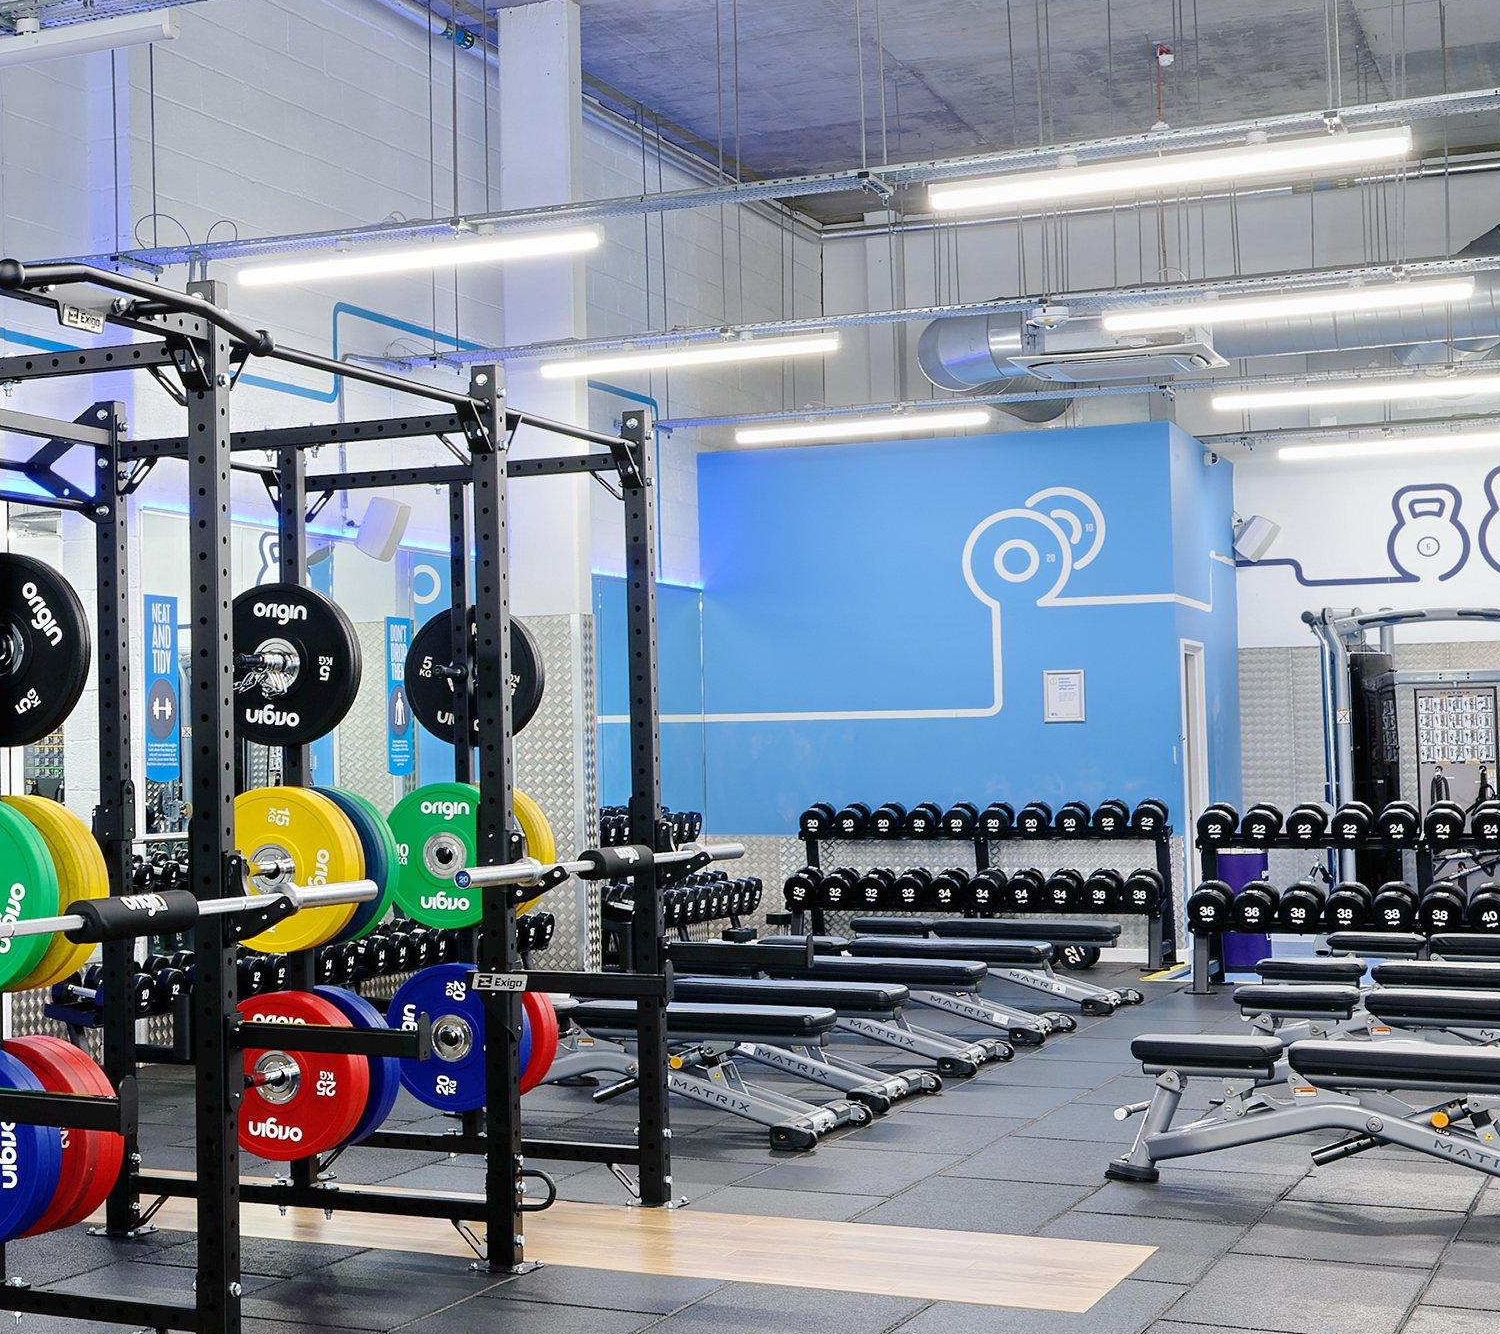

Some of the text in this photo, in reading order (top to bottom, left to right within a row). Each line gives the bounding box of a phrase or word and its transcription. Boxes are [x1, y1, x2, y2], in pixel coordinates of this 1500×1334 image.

[1085, 523, 1094, 531] 10
[1046, 553, 1056, 562] 20
[21, 581, 64, 647] origin
[152, 603, 171, 623] NEAT
[253, 602, 308, 626] origin
[152, 624, 172, 649] AND
[390, 625, 407, 642] DON'T
[152, 649, 172, 674] TIDY
[318, 656, 333, 667] KG
[422, 656, 432, 669] 5
[318, 666, 330, 681] 5
[418, 668, 432, 679] KG
[245, 704, 300, 728] origin
[420, 800, 470, 821] origin
[807, 819, 818, 827] 20
[843, 819, 854, 827] 20
[878, 819, 889, 827] 20
[914, 819, 925, 827] 20
[950, 819, 963, 827] 20
[987, 819, 999, 828] 20
[1025, 819, 1037, 828] 20
[1064, 819, 1076, 827] 20
[1102, 817, 1114, 827] 22
[1141, 817, 1153, 827] 22
[1208, 825, 1221, 833] 22
[1252, 825, 1265, 833] 22
[1298, 825, 1312, 833] 22
[1343, 824, 1357, 833] 22
[1390, 824, 1404, 833] 24
[1436, 824, 1450, 833] 24
[1484, 824, 1498, 833] 24
[458, 875, 468, 885] 20
[794, 887, 805, 896] 32
[829, 888, 841, 896] 32
[865, 889, 877, 897] 32
[902, 889, 915, 897] 32
[939, 889, 951, 897] 34
[976, 890, 989, 898] 34
[1015, 889, 1028, 898] 34
[1054, 890, 1066, 899] 34
[1093, 890, 1106, 899] 36
[1133, 890, 1146, 899] 36
[120, 893, 169, 917] origin
[420, 891, 470, 911] origin
[1200, 907, 1214, 916] 36
[1245, 907, 1260, 917] 36
[1291, 908, 1305, 918] 38
[1338, 909, 1352, 919] 38
[1385, 909, 1400, 919] 38
[1432, 910, 1448, 921] 38
[1482, 911, 1498, 922] 40
[1064, 945, 1081, 964] 22
[494, 979, 522, 989] Exigo
[1010, 971, 1049, 989] MATR
[142, 989, 149, 999] 10
[172, 984, 180, 994] 12
[930, 994, 991, 1020] MATRIX
[850, 1018, 915, 1047] MATRIX
[757, 1048, 829, 1080] MATRIX
[316, 1081, 336, 1097] 25
[436, 1075, 450, 1095] 20
[673, 1078, 750, 1113] MATRIX
[248, 1117, 303, 1143] origin
